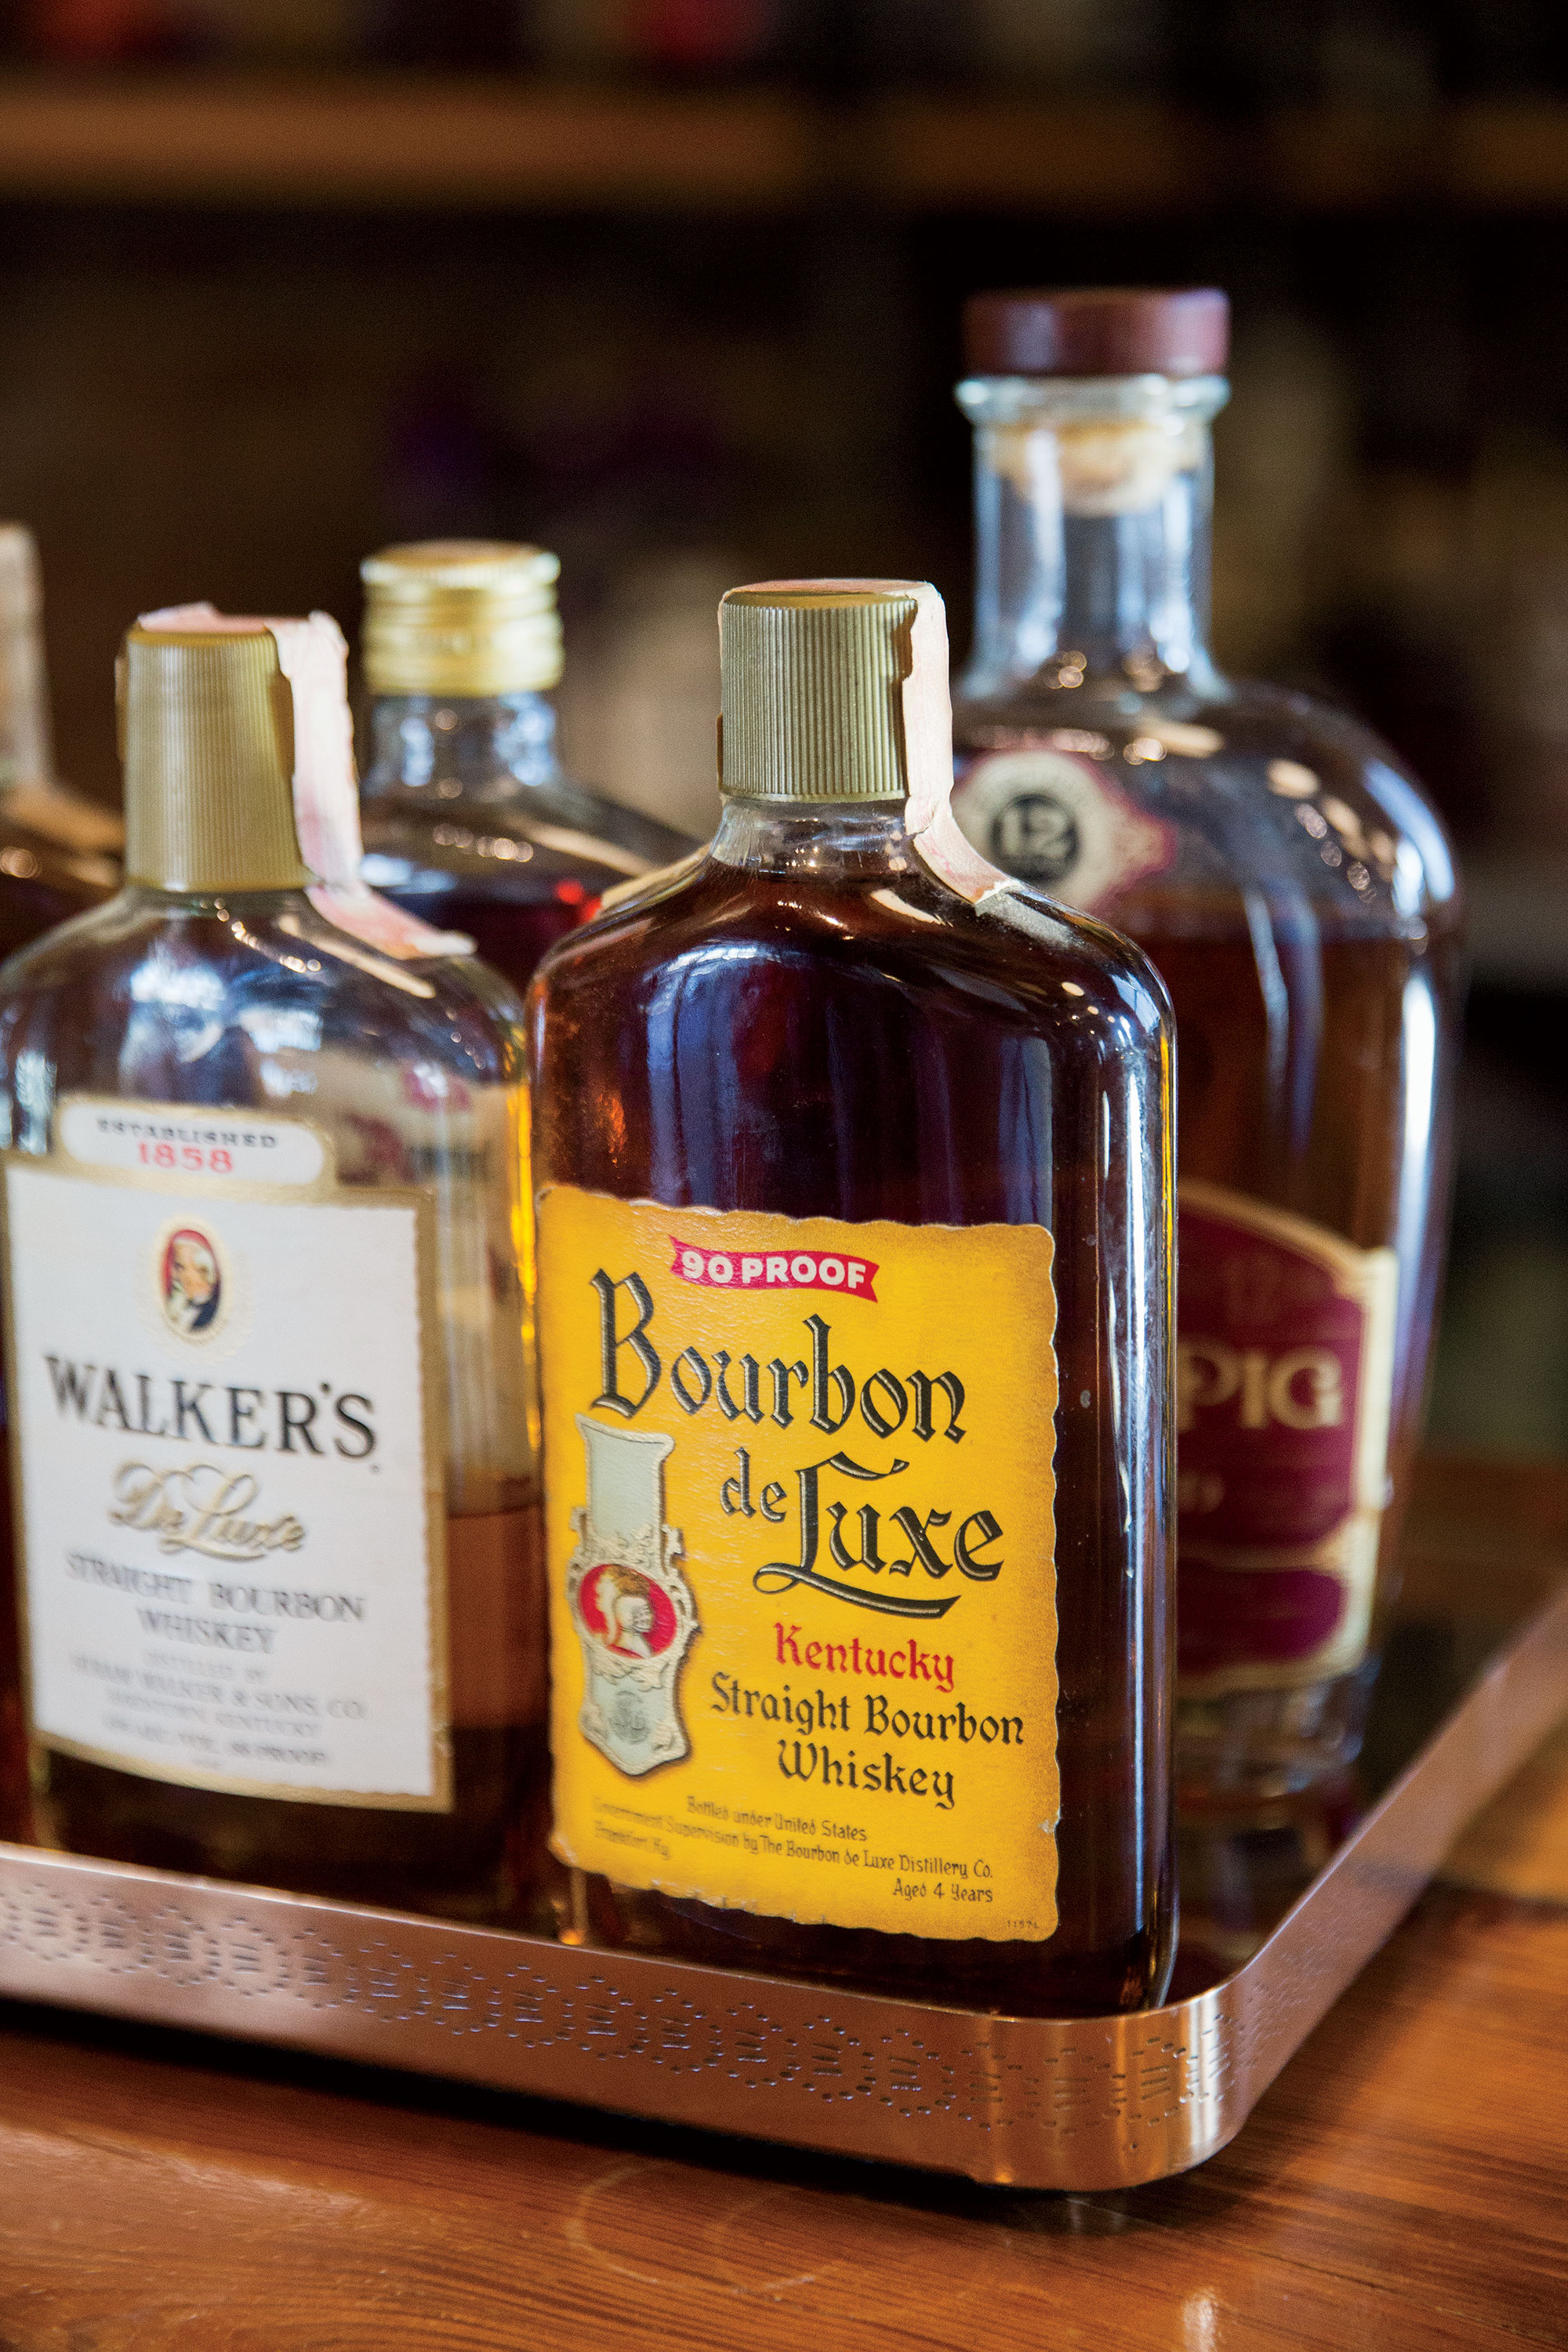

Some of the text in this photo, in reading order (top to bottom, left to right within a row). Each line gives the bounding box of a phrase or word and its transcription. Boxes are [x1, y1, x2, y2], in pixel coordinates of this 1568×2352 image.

[1002, 805, 1070, 858] 12
[96, 1117, 277, 1149] ESTABLISHED
[138, 1139, 234, 1174] 1858
[682, 1250, 867, 1290] 90 PROOF
[590, 1268, 967, 1444] Bourbon
[45, 1354, 376, 1461] WALKER'S
[720, 1446, 1004, 1620] de Luxe
[67, 1552, 365, 1622] STRAIGHT BOURBON
[138, 1607, 278, 1653] WHISKEY
[772, 1622, 956, 1693] Kentucky
[710, 1671, 1024, 1745] Straight Bourbon
[777, 1739, 956, 1809] Whiskey
[687, 1795, 868, 1842] Bottled under United States
[743, 1832, 760, 1856] by
[759, 1835, 782, 1856] The
[786, 1840, 841, 1864] Bourbon
[844, 1851, 860, 1867] de
[863, 1849, 895, 1871] Luxe
[899, 1854, 968, 1880] Distillery
[972, 1859, 994, 1879] Co.
[892, 1878, 994, 1904] Aged 4 Years
